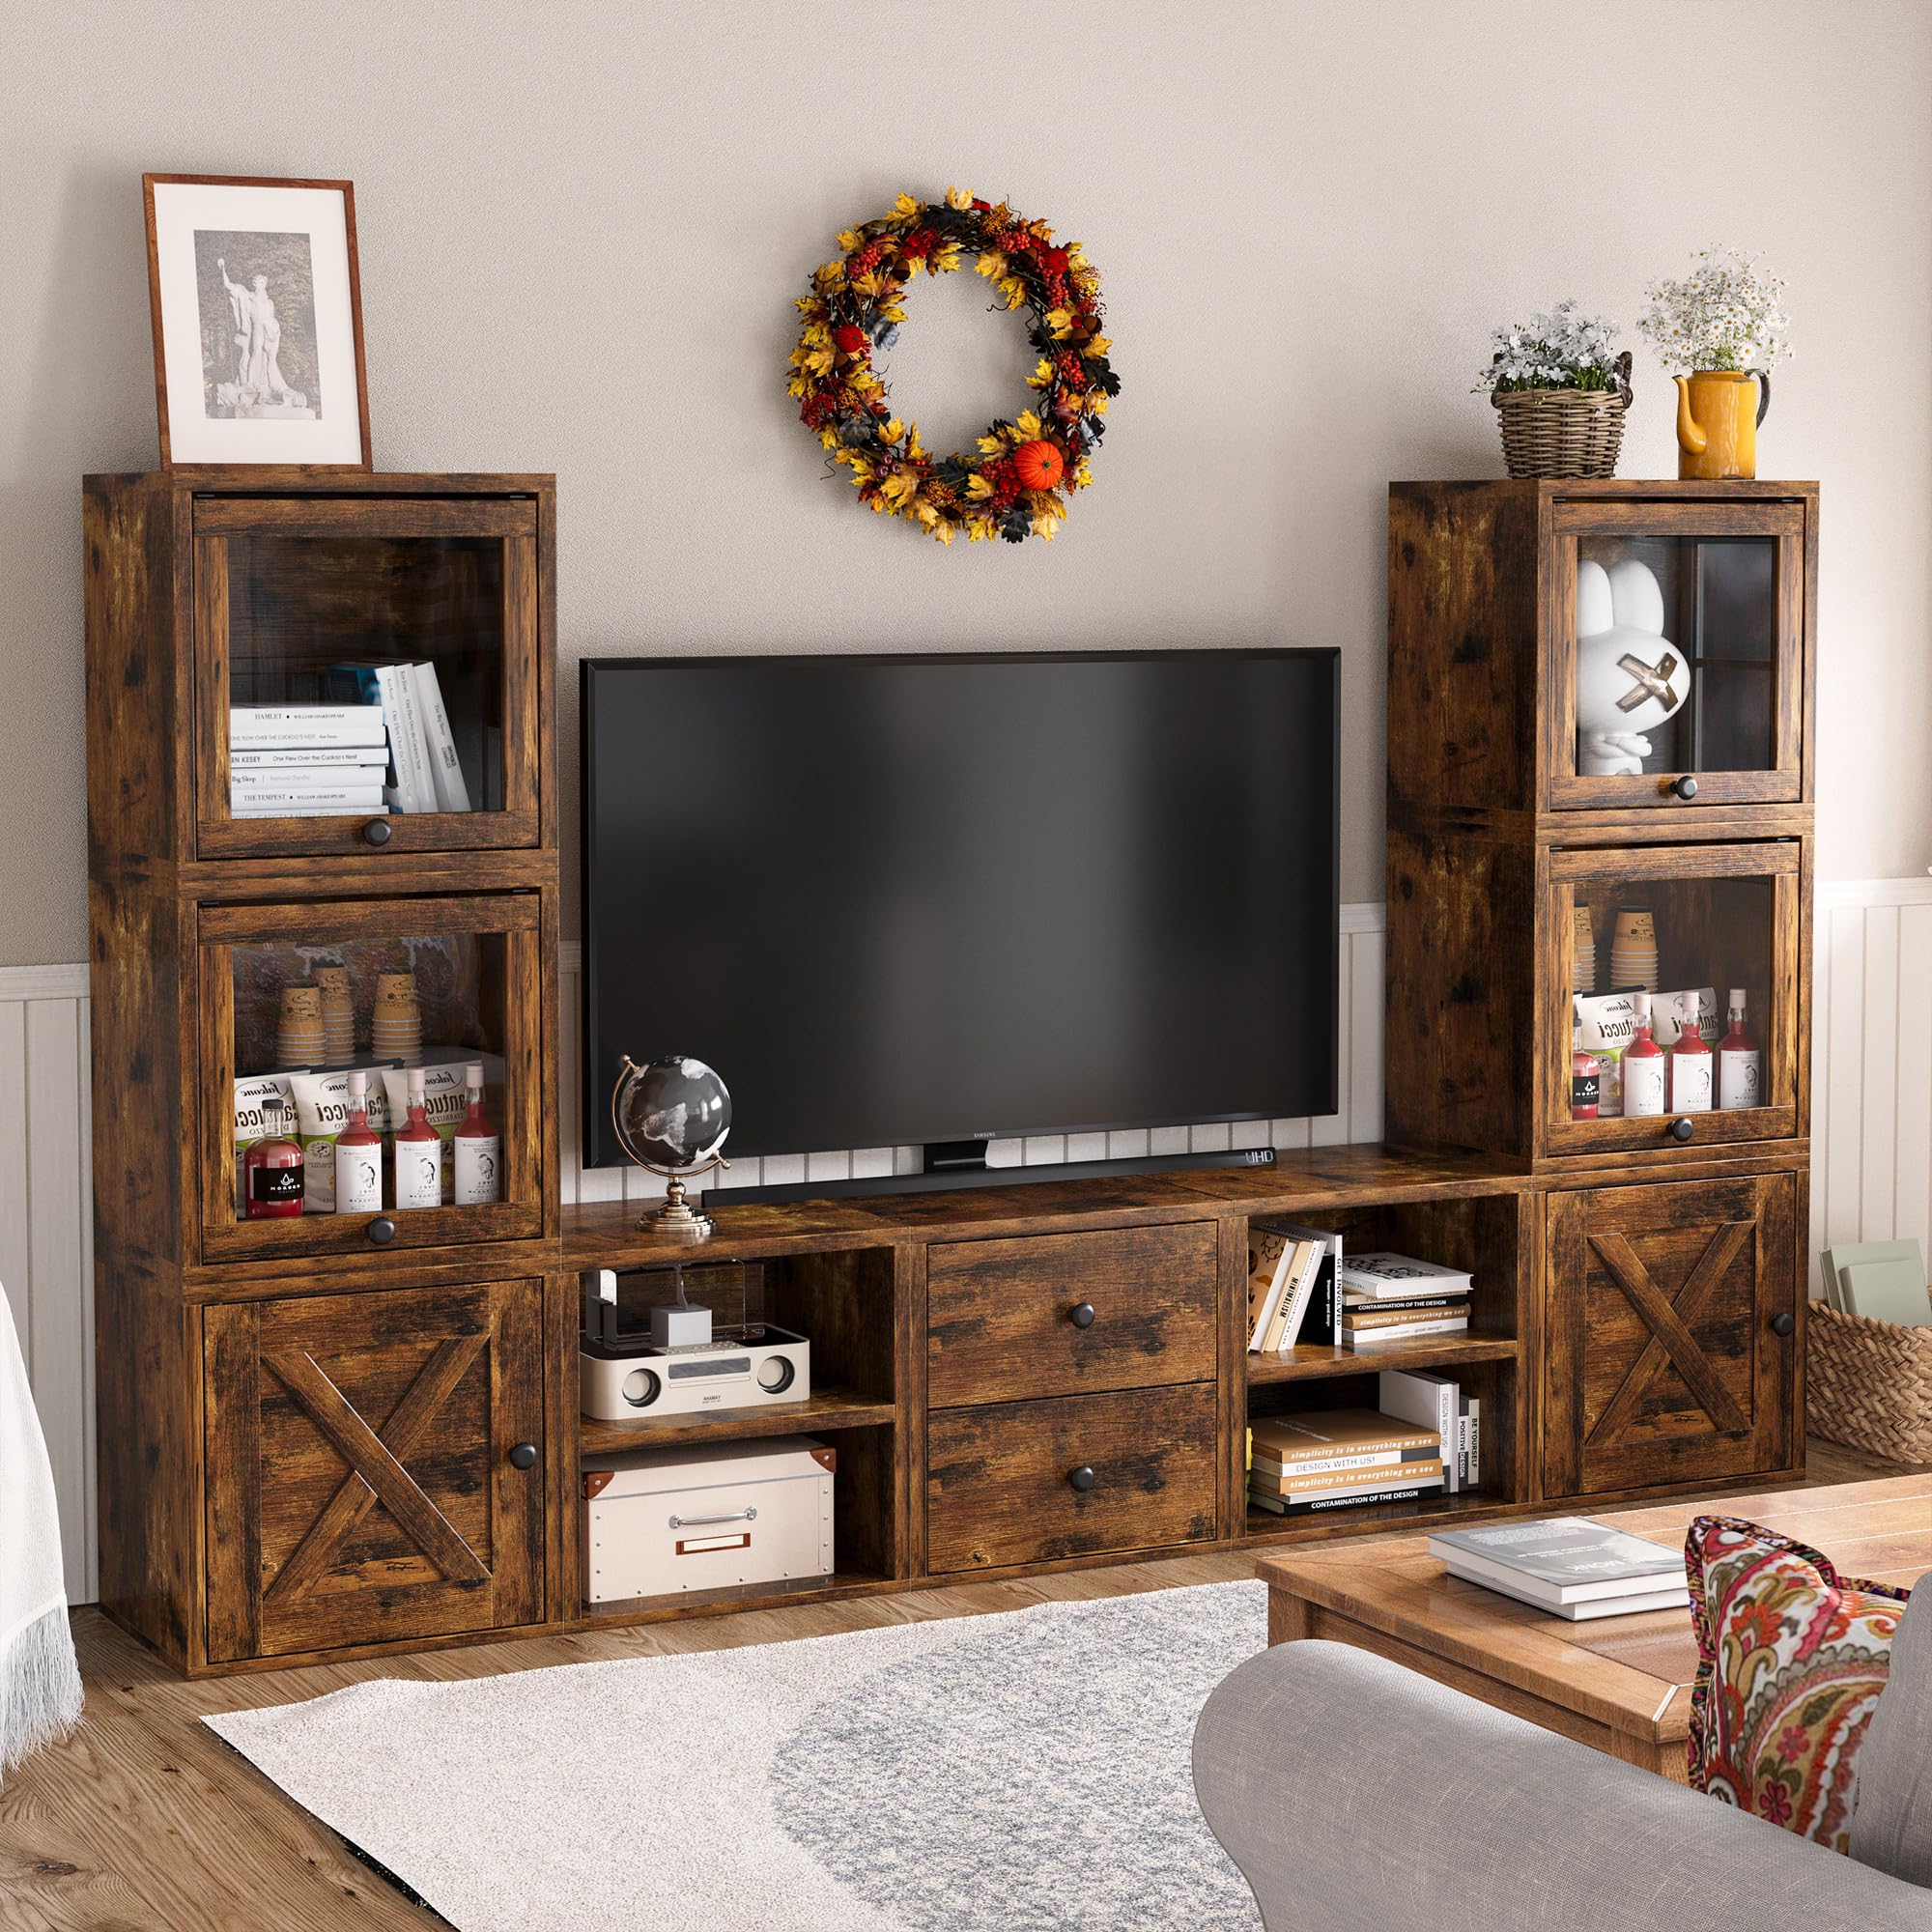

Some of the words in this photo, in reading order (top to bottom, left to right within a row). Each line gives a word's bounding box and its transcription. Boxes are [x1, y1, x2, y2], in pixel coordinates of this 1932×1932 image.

[1280, 1277, 1299, 1318] MINIMALISM
[1360, 1318, 1392, 1326] simplicity
[1409, 1311, 1443, 1321] everything
[1472, 1418, 1477, 1428] BE
[1291, 1448, 1334, 1460] simplicity
[1357, 1441, 1402, 1453] everything
[1296, 1462, 1331, 1473] DESIGN
[1333, 1458, 1358, 1468] WITH
[1360, 1456, 1376, 1465] US!
[1290, 1477, 1333, 1489] simplicity
[1346, 1474, 1355, 1482] in
[1357, 1468, 1402, 1481] everything
[1311, 1497, 1369, 1509] CONTAMINATION
[1393, 1490, 1419, 1499] DESIGN
